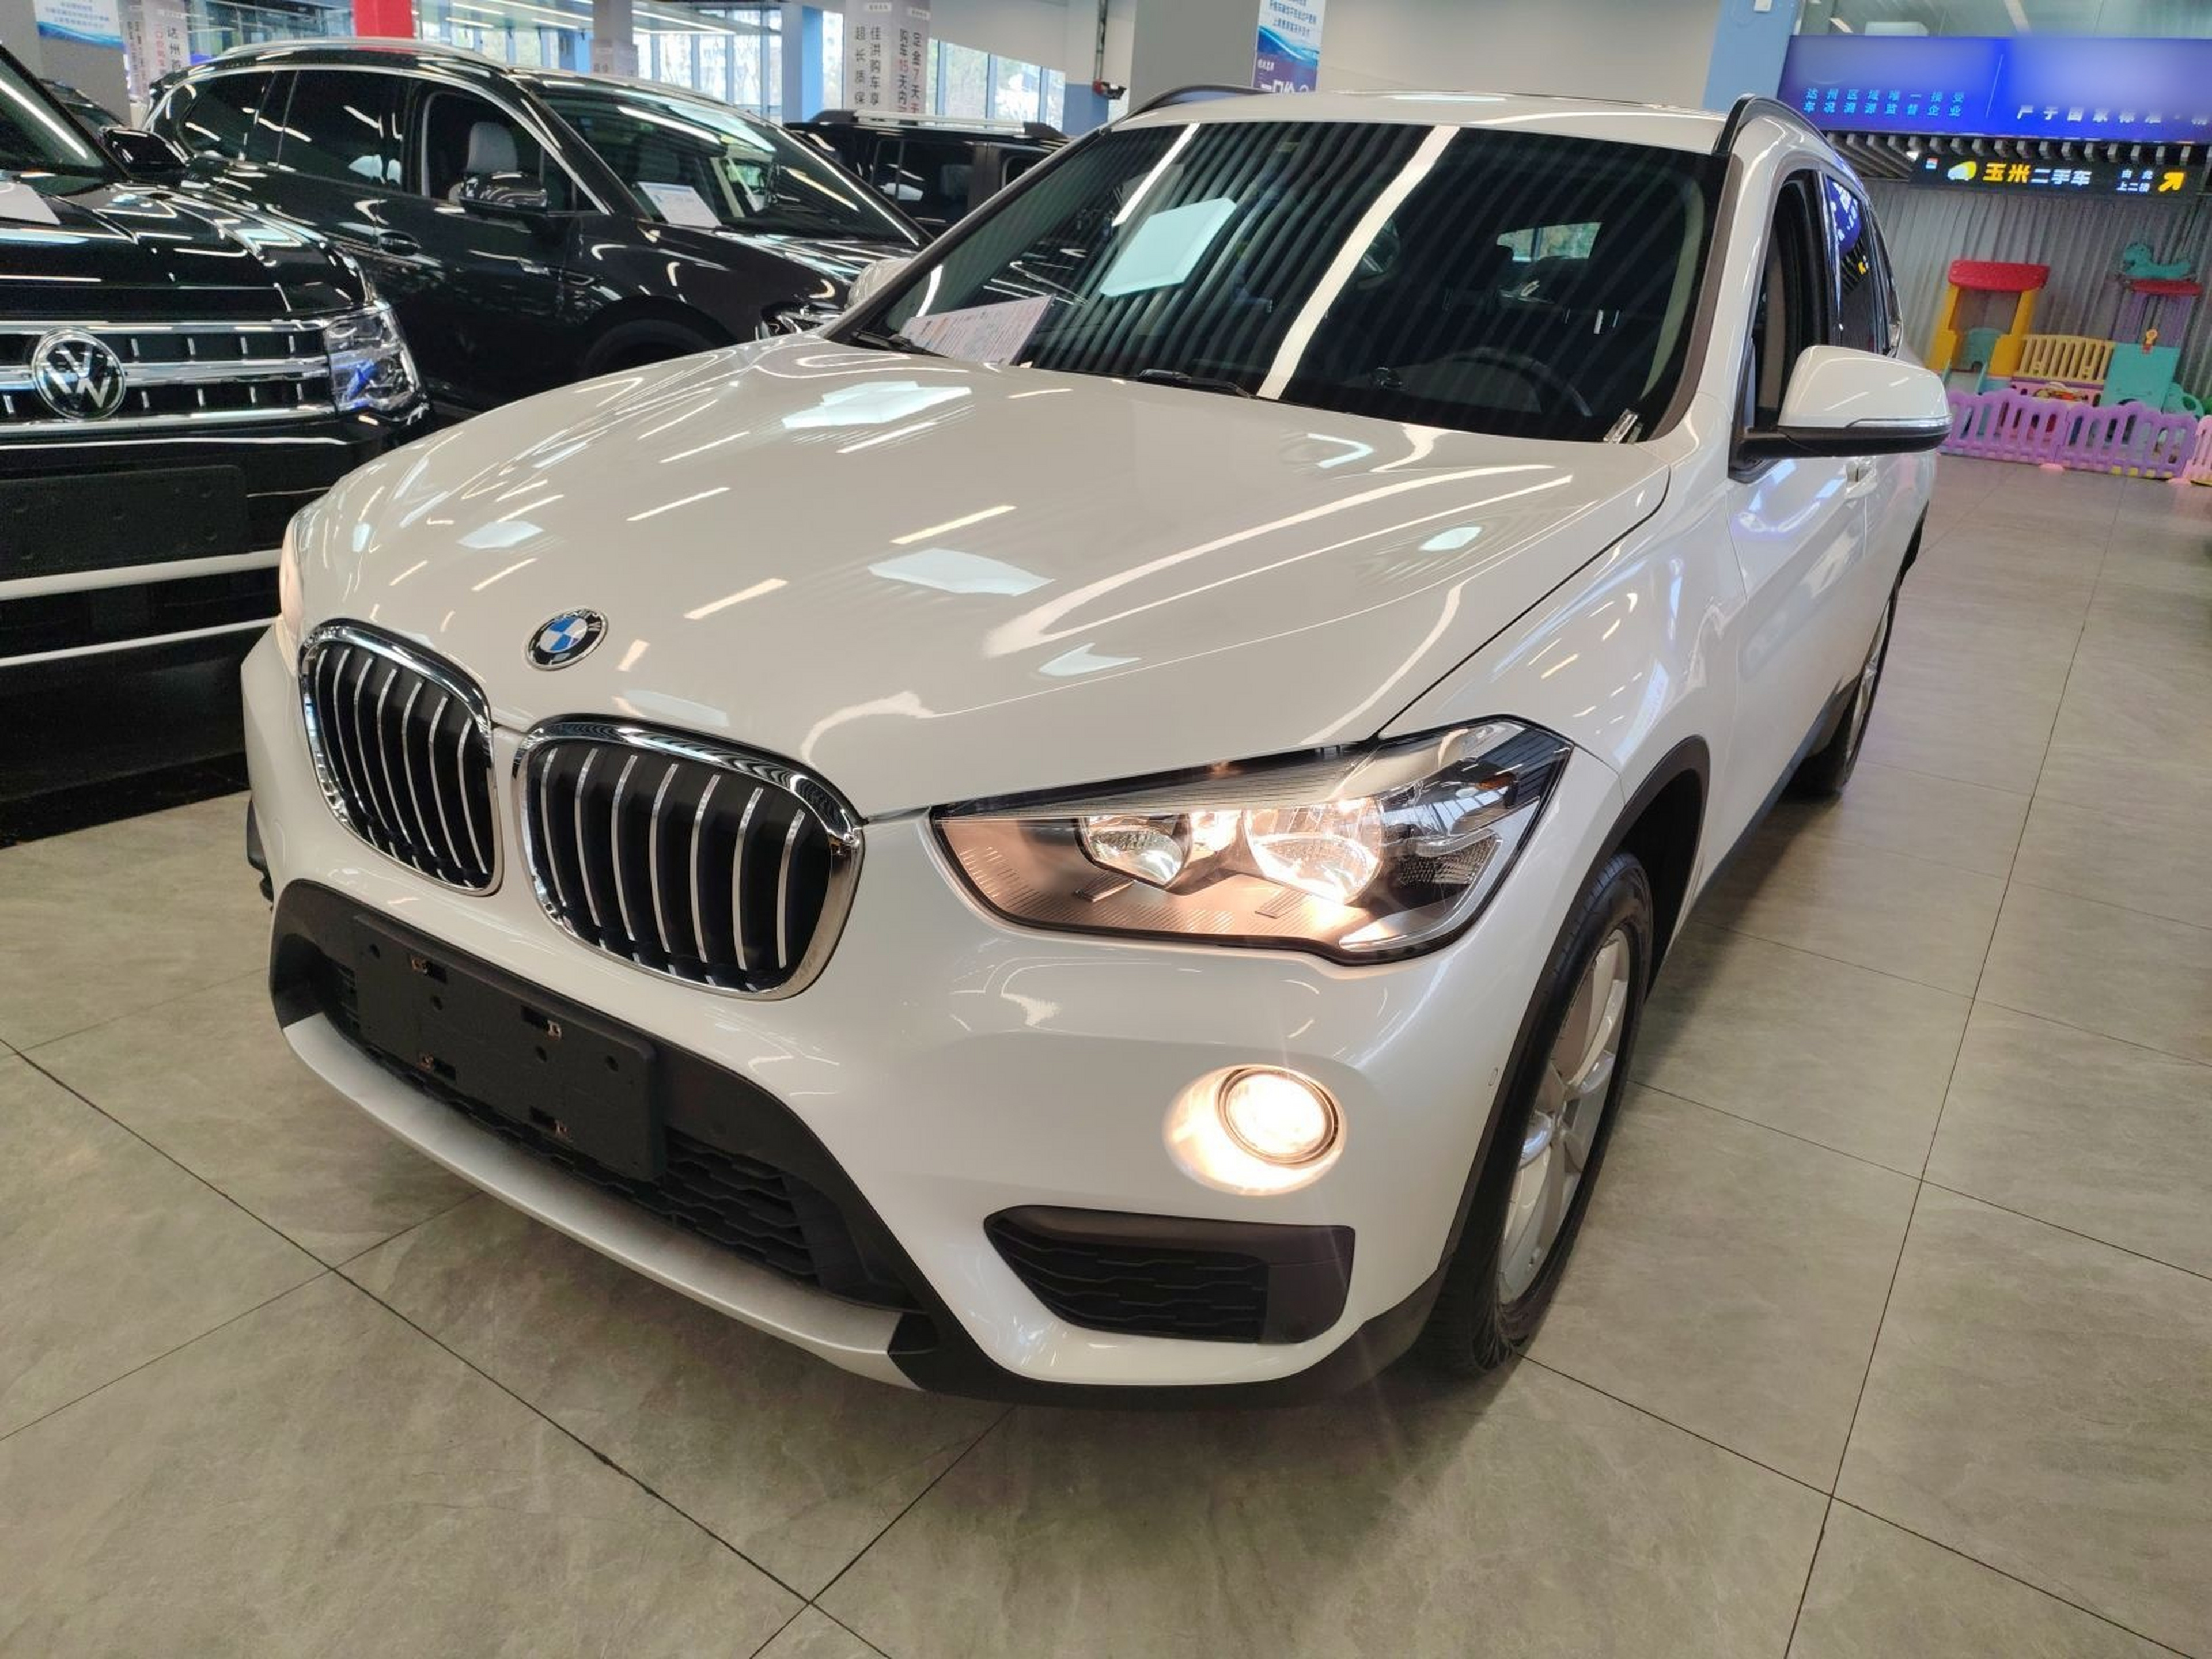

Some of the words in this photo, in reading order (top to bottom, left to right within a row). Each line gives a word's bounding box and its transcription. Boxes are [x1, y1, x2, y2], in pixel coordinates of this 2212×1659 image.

[1982, 162, 2092, 186] 玉米二手车
